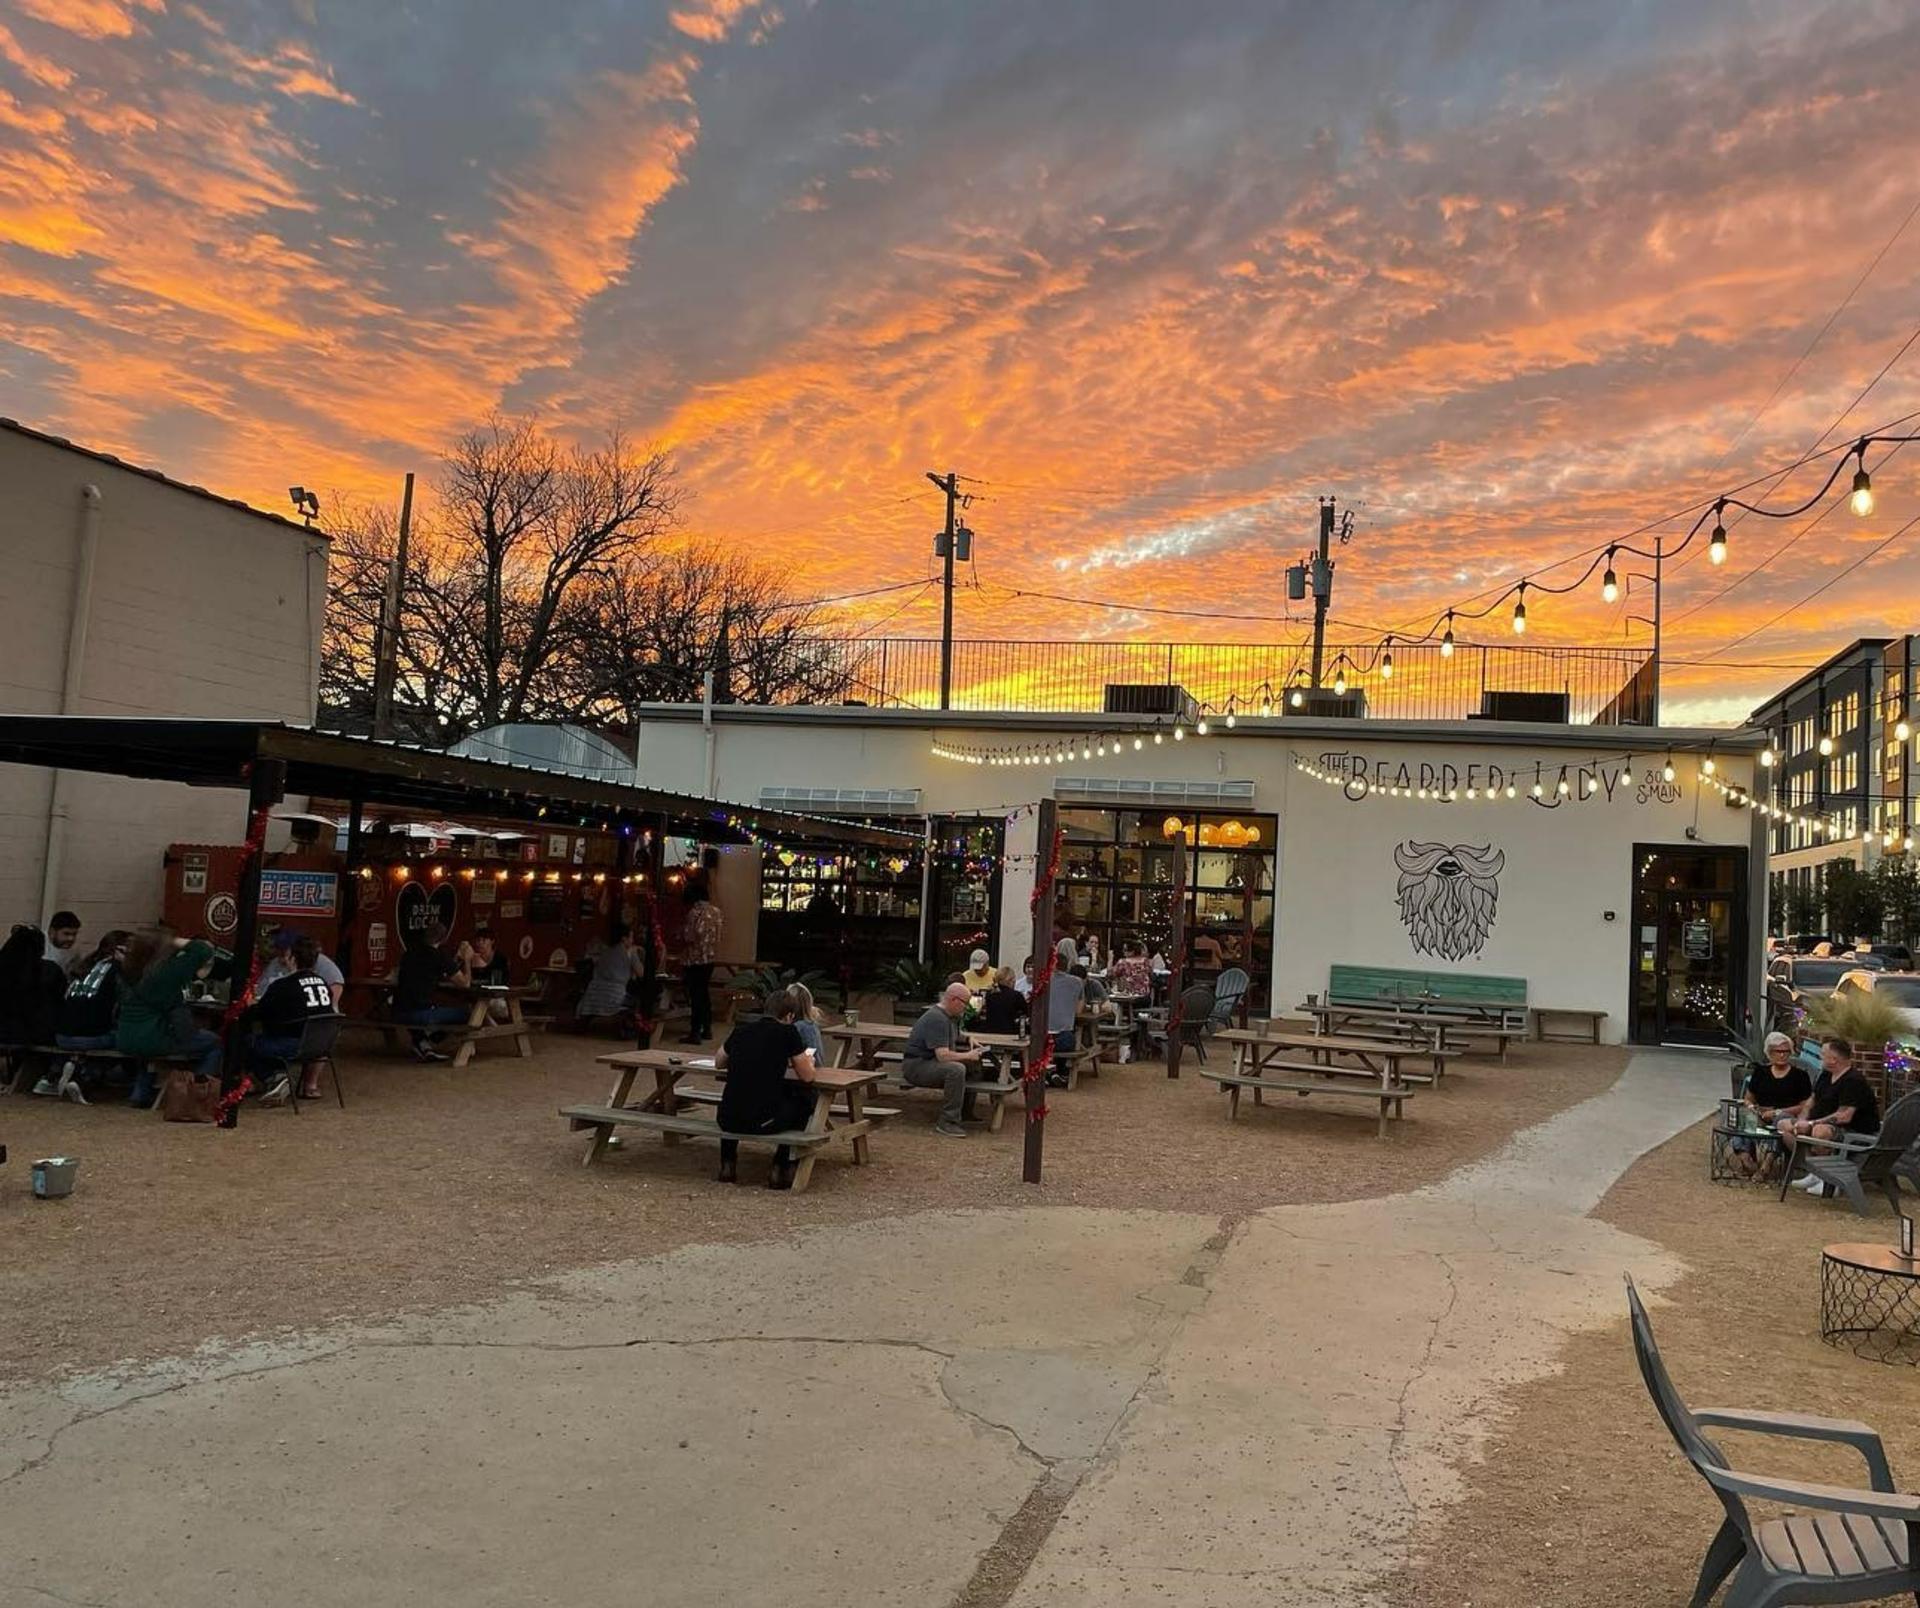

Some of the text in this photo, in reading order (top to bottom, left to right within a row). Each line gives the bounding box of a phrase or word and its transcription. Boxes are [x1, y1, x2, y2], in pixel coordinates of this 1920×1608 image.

[1319, 750, 1620, 809] THE BEARDED LADY
[260, 880, 319, 905] BEER
[411, 903, 441, 916] DRINK
[303, 985, 331, 1008] 18
